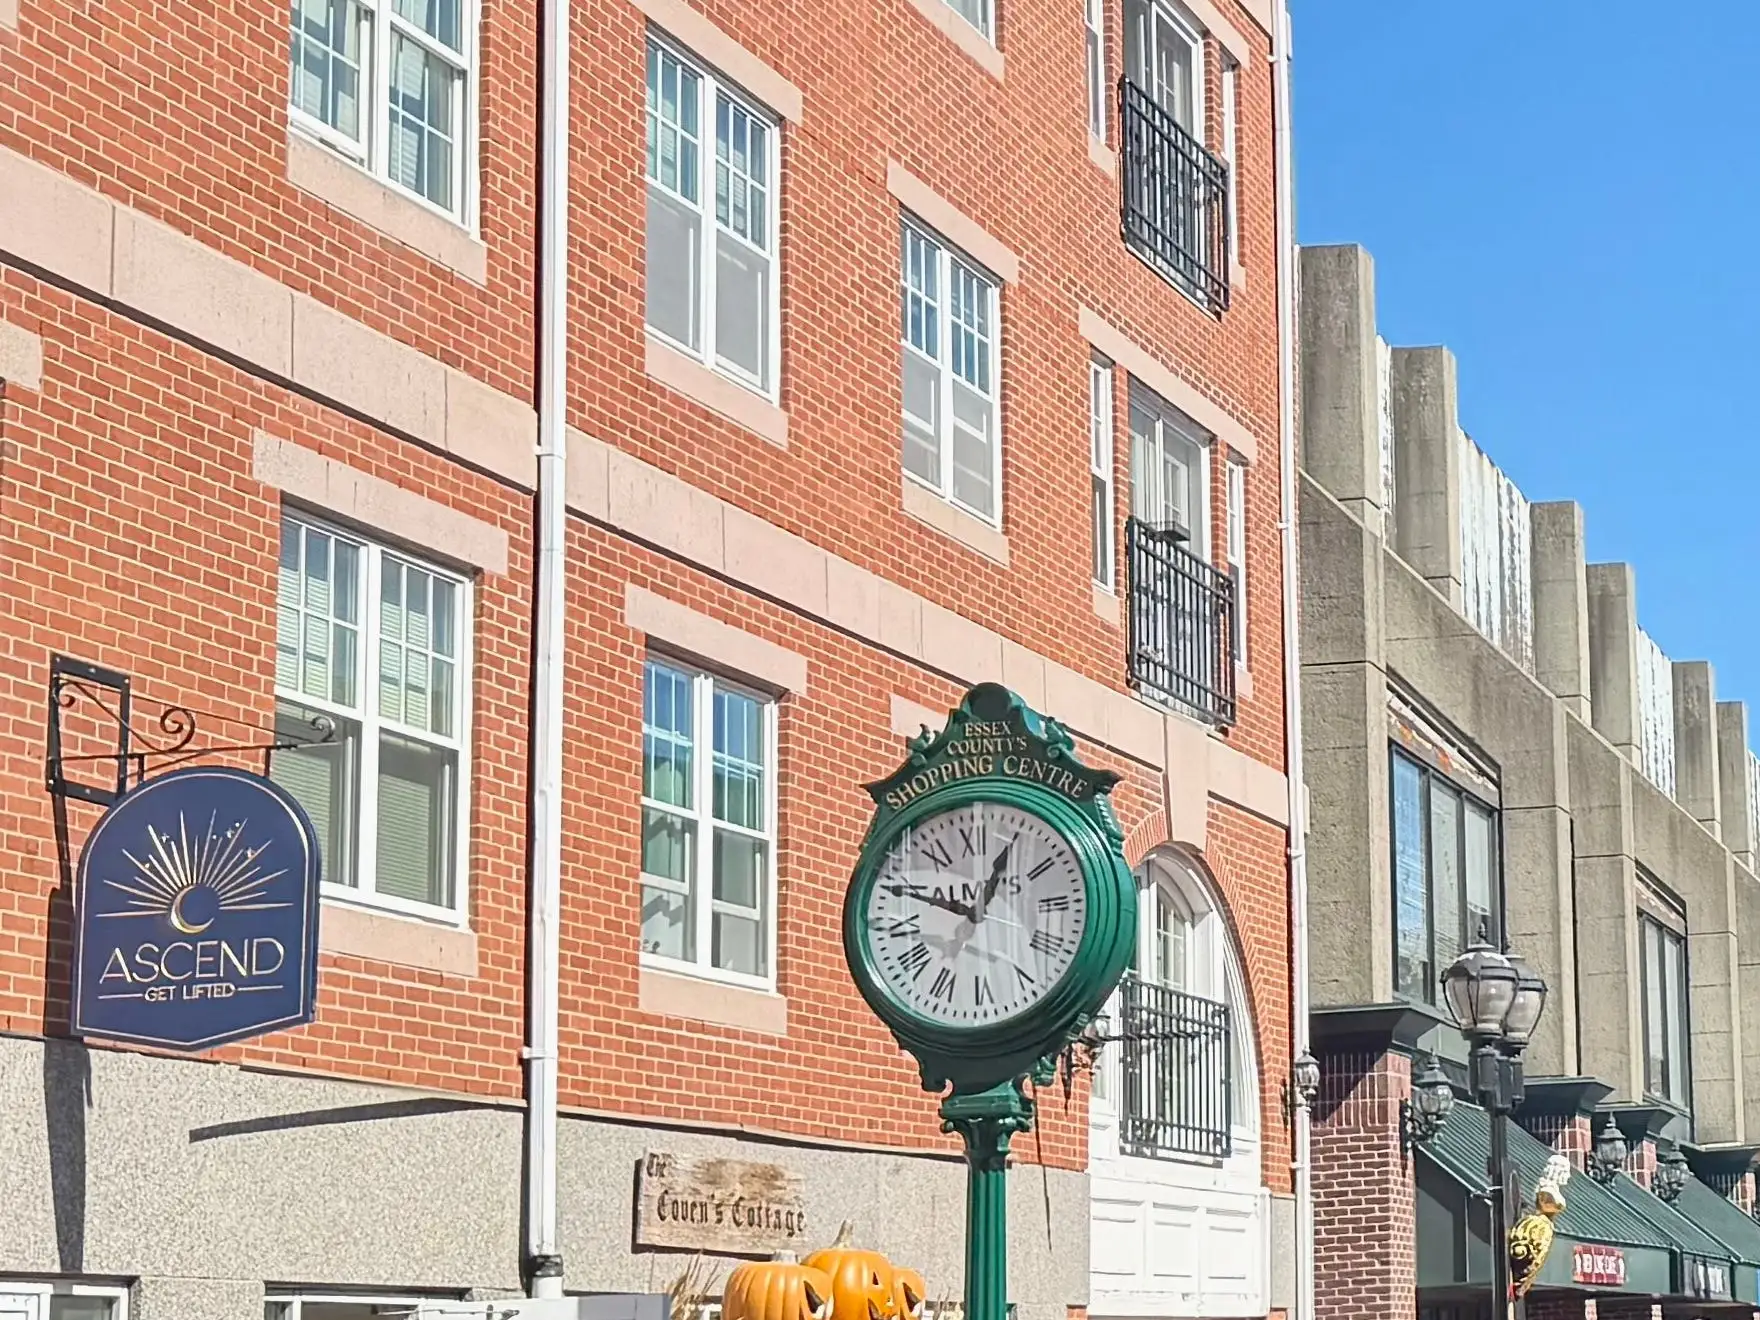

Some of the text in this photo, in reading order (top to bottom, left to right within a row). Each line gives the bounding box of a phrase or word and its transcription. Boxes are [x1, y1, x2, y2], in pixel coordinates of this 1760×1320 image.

[965, 720, 1012, 737] ESSEX
[947, 735, 1027, 756] COUNTY'S
[885, 755, 1088, 811] SHOPPING CENTRE
[932, 874, 1022, 901] ALM'S
[99, 937, 285, 985] ASCEND
[144, 982, 236, 1002] GET LIFTED
[657, 1189, 806, 1237] Coven's Cottage
